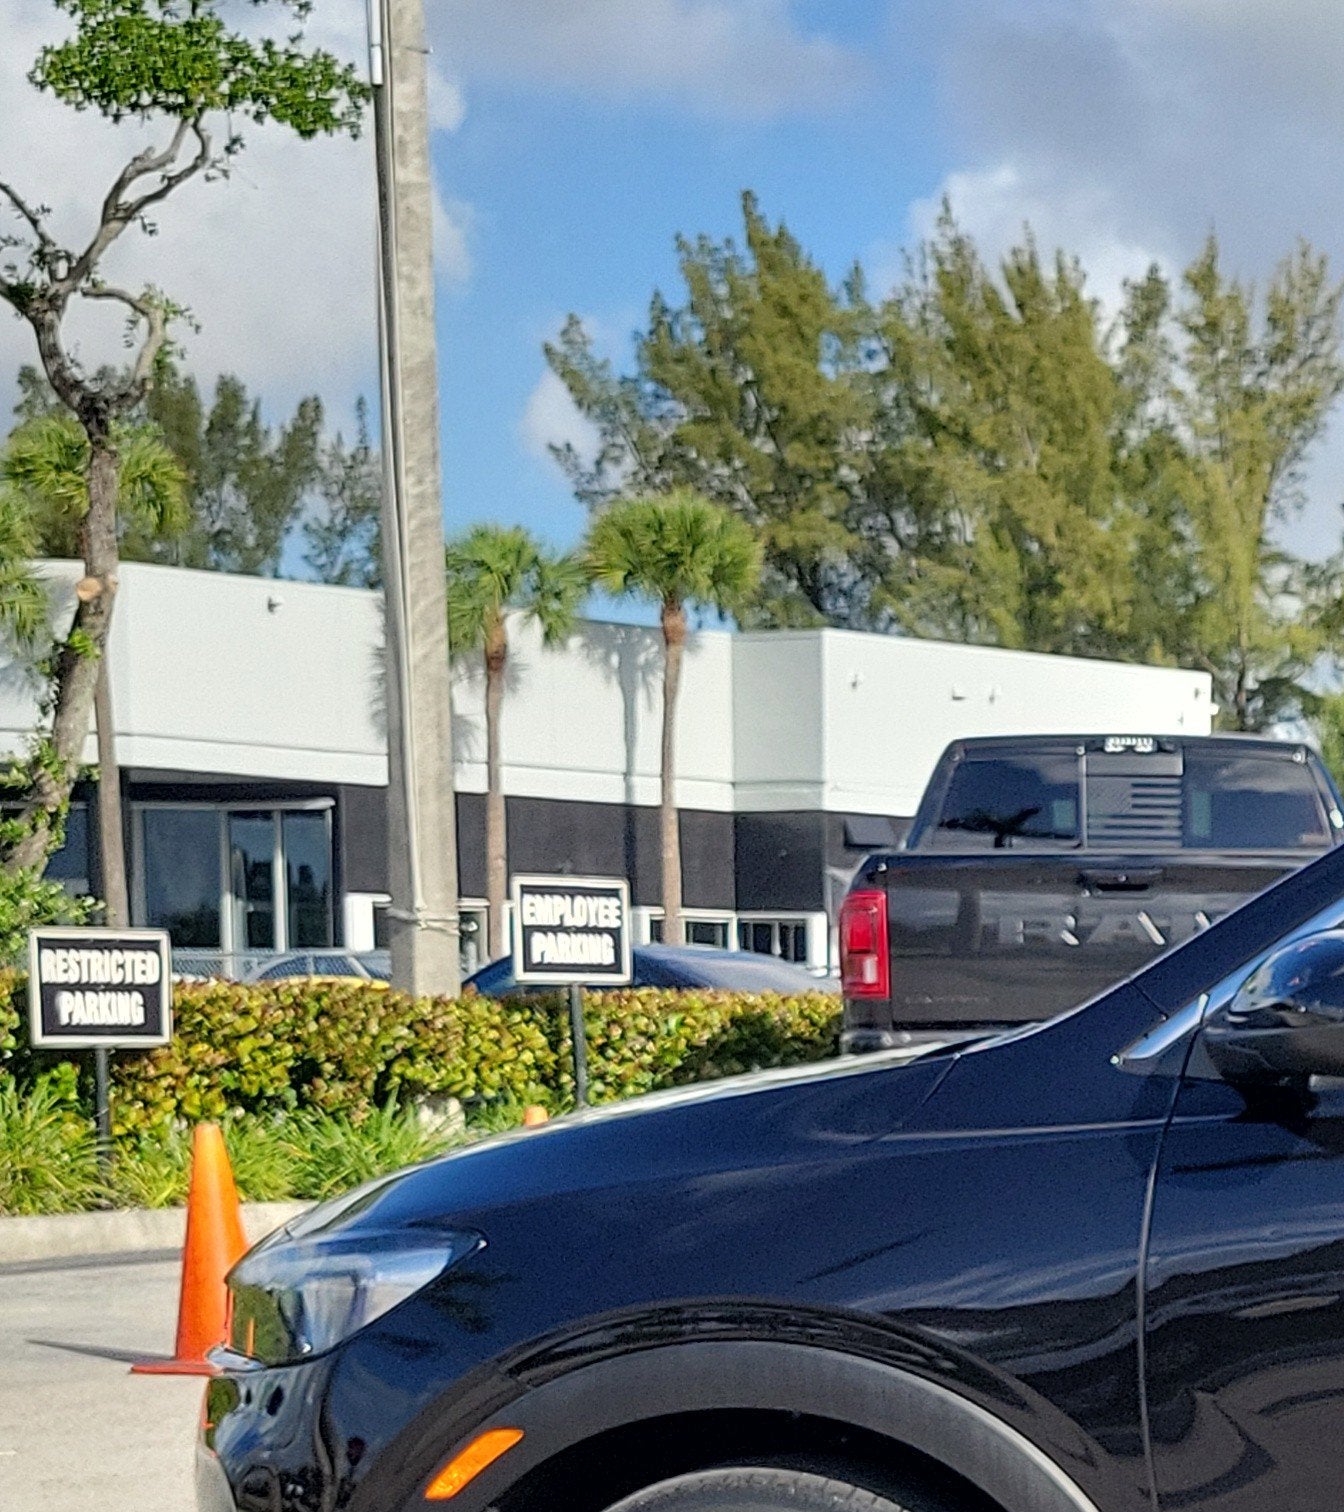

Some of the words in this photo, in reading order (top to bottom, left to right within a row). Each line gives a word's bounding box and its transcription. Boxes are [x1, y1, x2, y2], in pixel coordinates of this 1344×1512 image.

[522, 893, 621, 928] EMPLOYEE
[531, 931, 616, 966] PARKING
[40, 948, 160, 985] RESTRICTED
[56, 990, 146, 1026] PARKING
